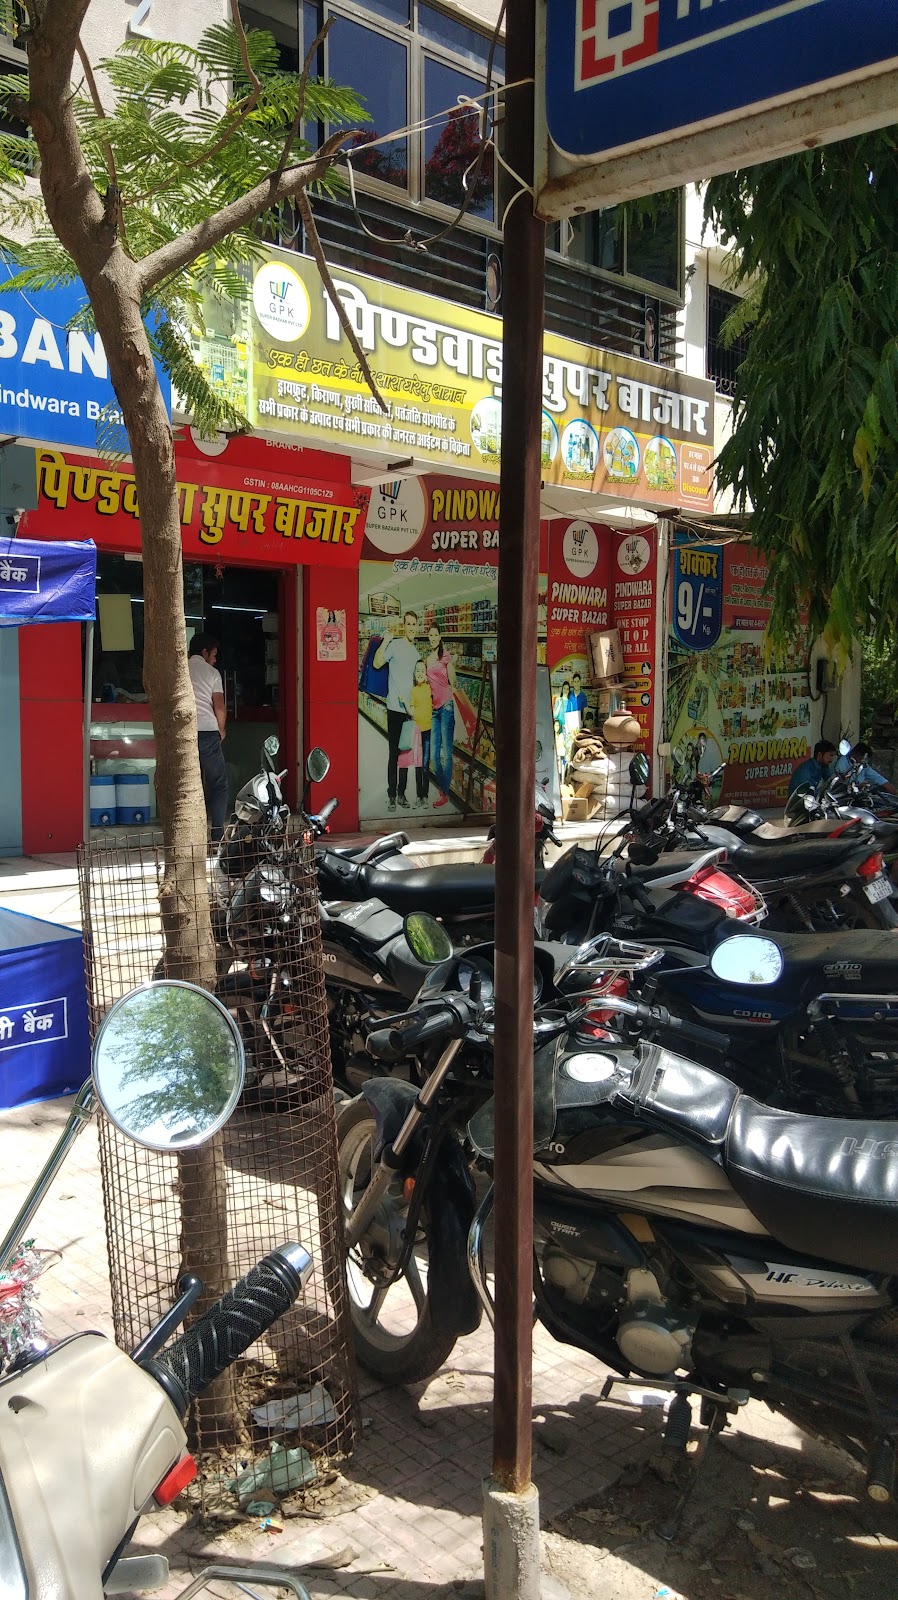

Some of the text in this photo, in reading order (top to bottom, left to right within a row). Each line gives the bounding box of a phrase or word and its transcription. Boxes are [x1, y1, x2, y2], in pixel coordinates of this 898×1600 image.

[0, 309, 107, 379] BAN
[323, 278, 503, 397] पिण्डवाड़
[616, 376, 709, 436] बाजार
[268, 348, 294, 368] एक
[295, 350, 310, 372] ही
[311, 357, 333, 377] छत
[333, 357, 349, 379] के
[376, 371, 404, 392] सारा
[431, 383, 467, 404] सामान
[0, 384, 80, 417] indwara
[258, 398, 277, 417] सभी
[277, 402, 300, 421] प्रकार
[300, 405, 309, 423] के
[310, 410, 332, 428] उत्पाद
[333, 412, 345, 431] एवं
[345, 416, 361, 435] सभी
[361, 421, 381, 439] प्रकार
[381, 423, 393, 440] की
[393, 428, 417, 445] जनरल
[441, 435, 449, 451] के
[449, 437, 472, 457] विक्रेता
[448, 415, 457, 431] के
[243, 477, 266, 489] GSTIN
[682, 482, 708, 496] Discount
[200, 485, 272, 545] सुपर
[274, 496, 361, 546] बाजार
[365, 522, 382, 531] SUPER
[382, 524, 400, 532] BAZAAR
[431, 530, 479, 550] SUPER
[0, 560, 28, 582] बैंक
[680, 548, 719, 579] शक्कर
[551, 581, 608, 608] PINDWARA
[615, 580, 653, 598] PINDWARA
[614, 598, 652, 611] SUPER BAZAR
[551, 607, 608, 626] SUPER BAZAR
[617, 617, 649, 629] ONE STOP
[634, 642, 649, 653] ALL
[728, 736, 807, 765] PINDWARA
[745, 763, 793, 780] SUPER BAZAR
[612, 922, 634, 931] HONDA
[321, 952, 337, 963] ero
[22, 1009, 54, 1034] बैंक
